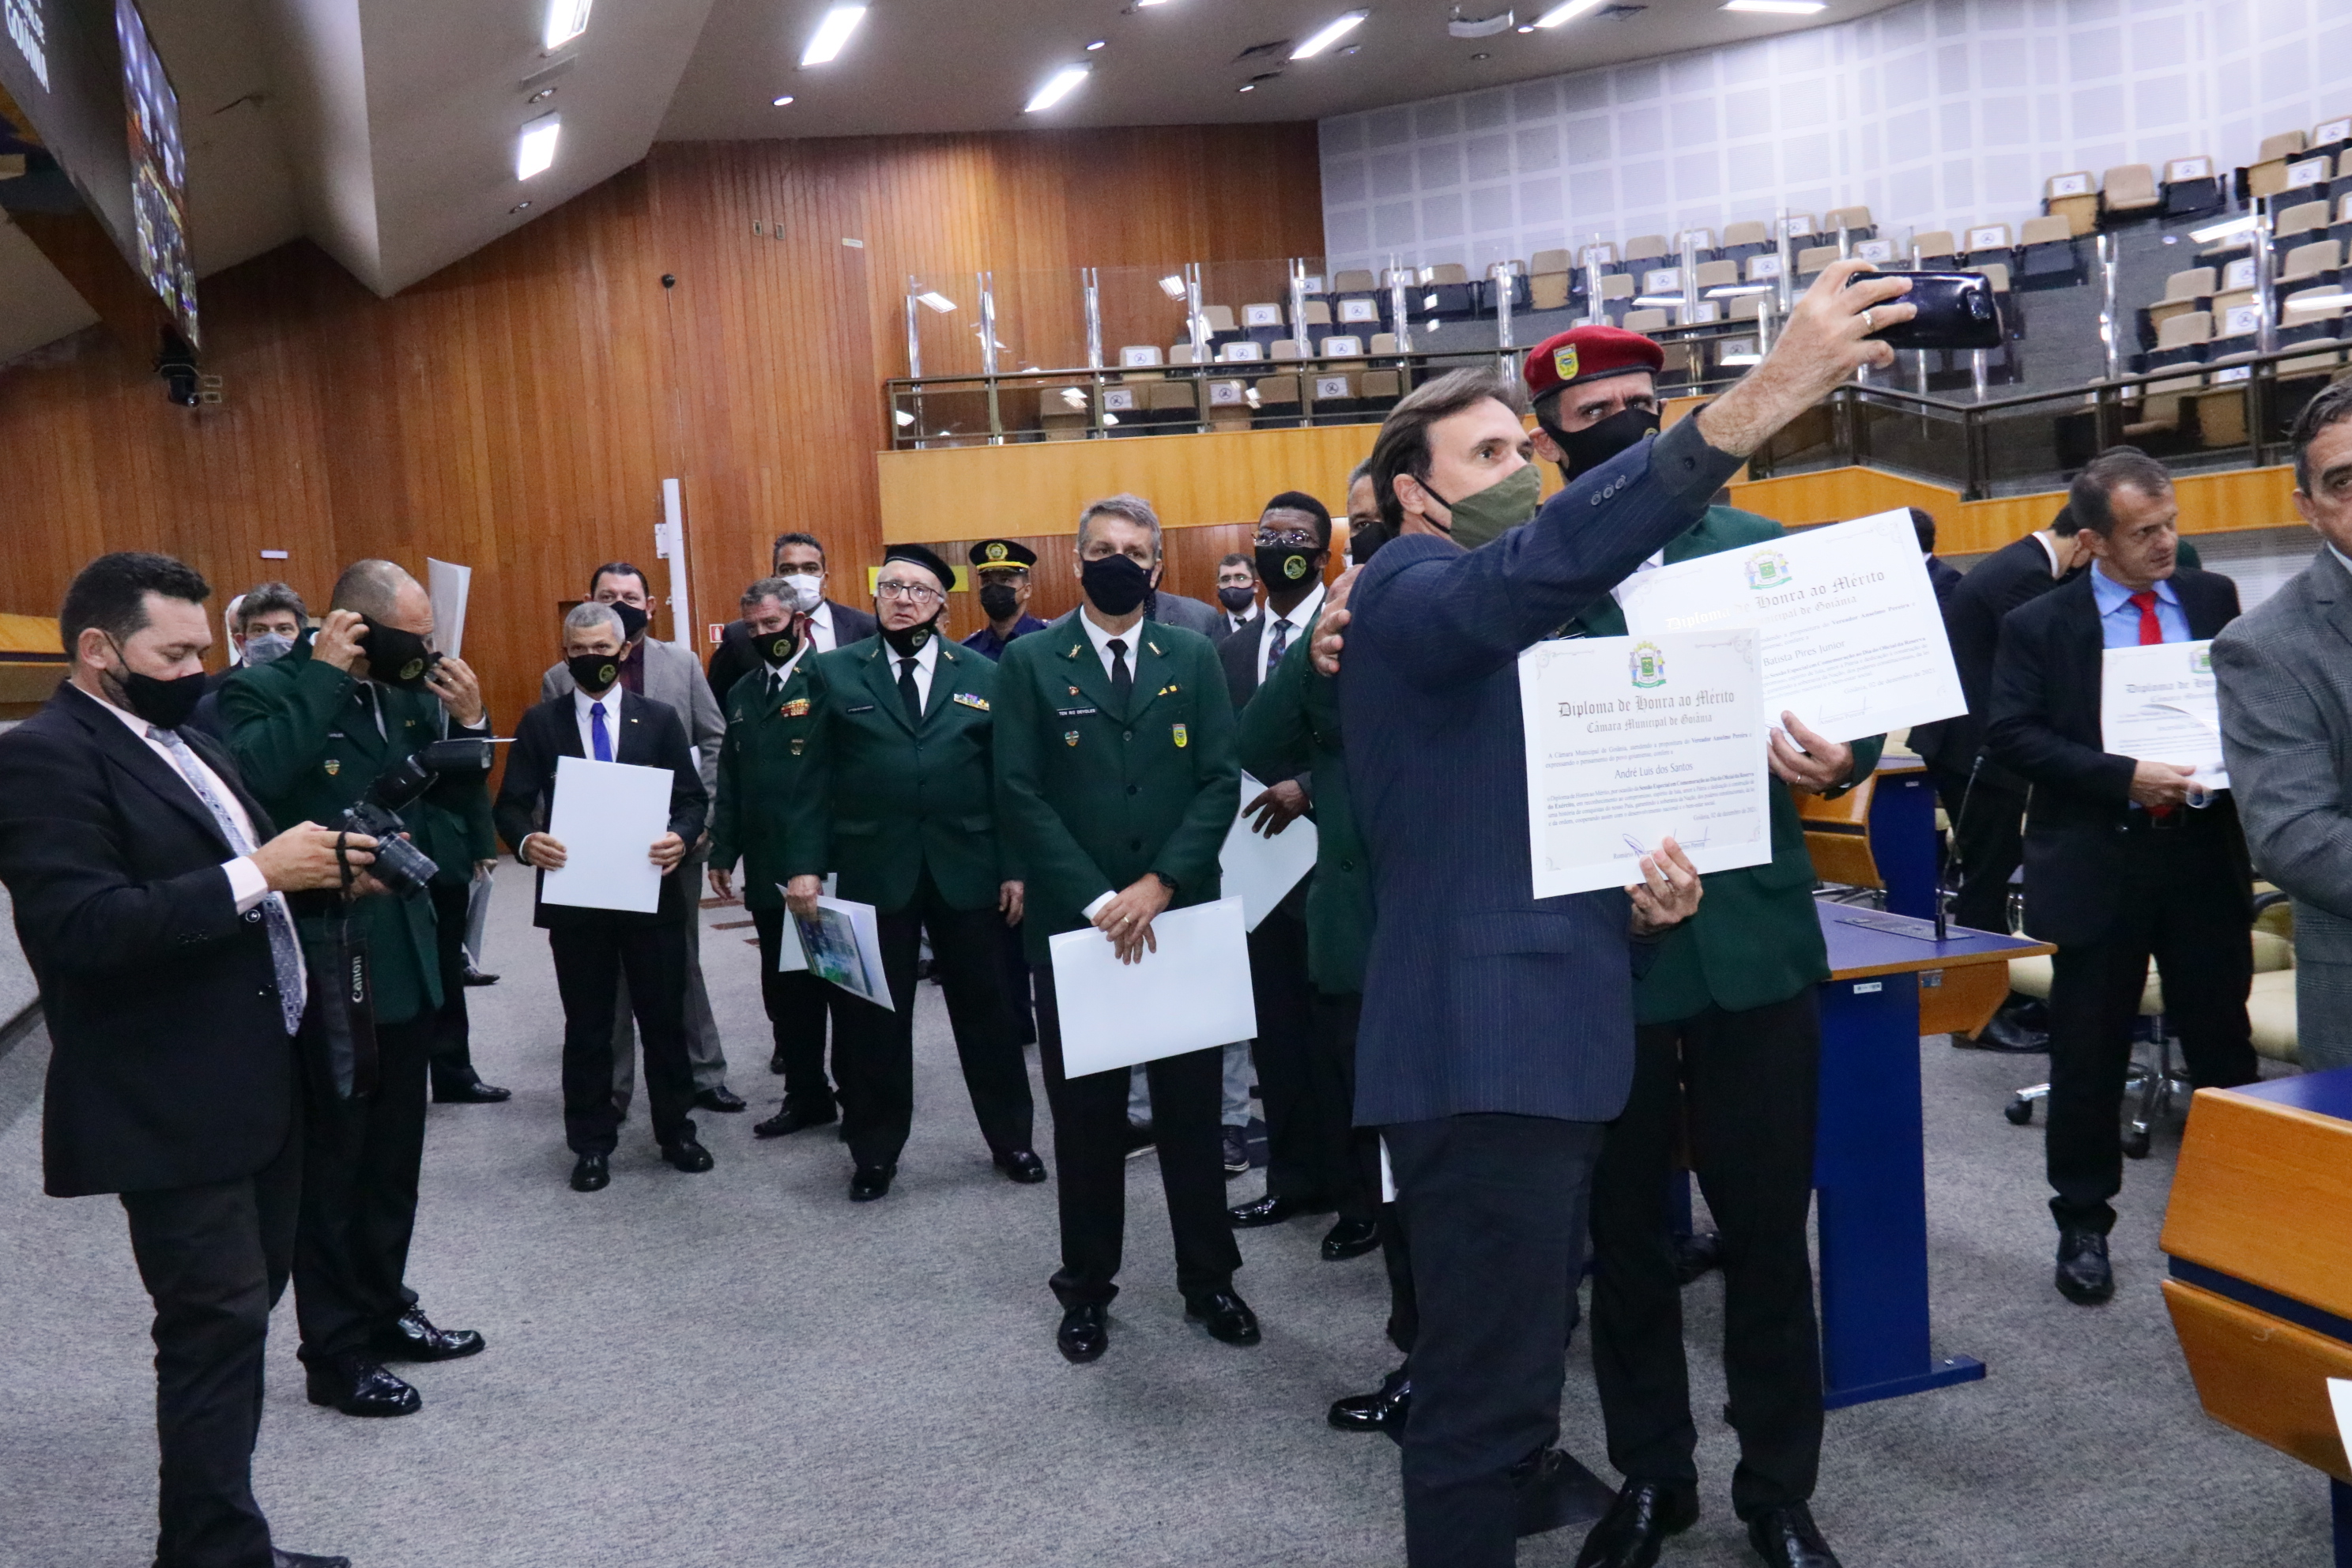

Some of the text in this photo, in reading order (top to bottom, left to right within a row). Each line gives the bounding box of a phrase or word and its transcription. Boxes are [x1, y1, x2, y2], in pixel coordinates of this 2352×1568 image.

[1755, 591, 1804, 609] Honra
[1811, 586, 1826, 597] ao
[1833, 572, 1884, 593] Mérito
[1815, 597, 1856, 611] Goiânia
[1763, 641, 1845, 666] Batista Pires Junior
[1559, 689, 1734, 717] Diploma de Honra ao Mérito
[1587, 712, 1712, 733] Câmara Municipal de Goiânia
[1615, 763, 1693, 778] André Luis dos Santos
[352, 956, 364, 1003] Canon
